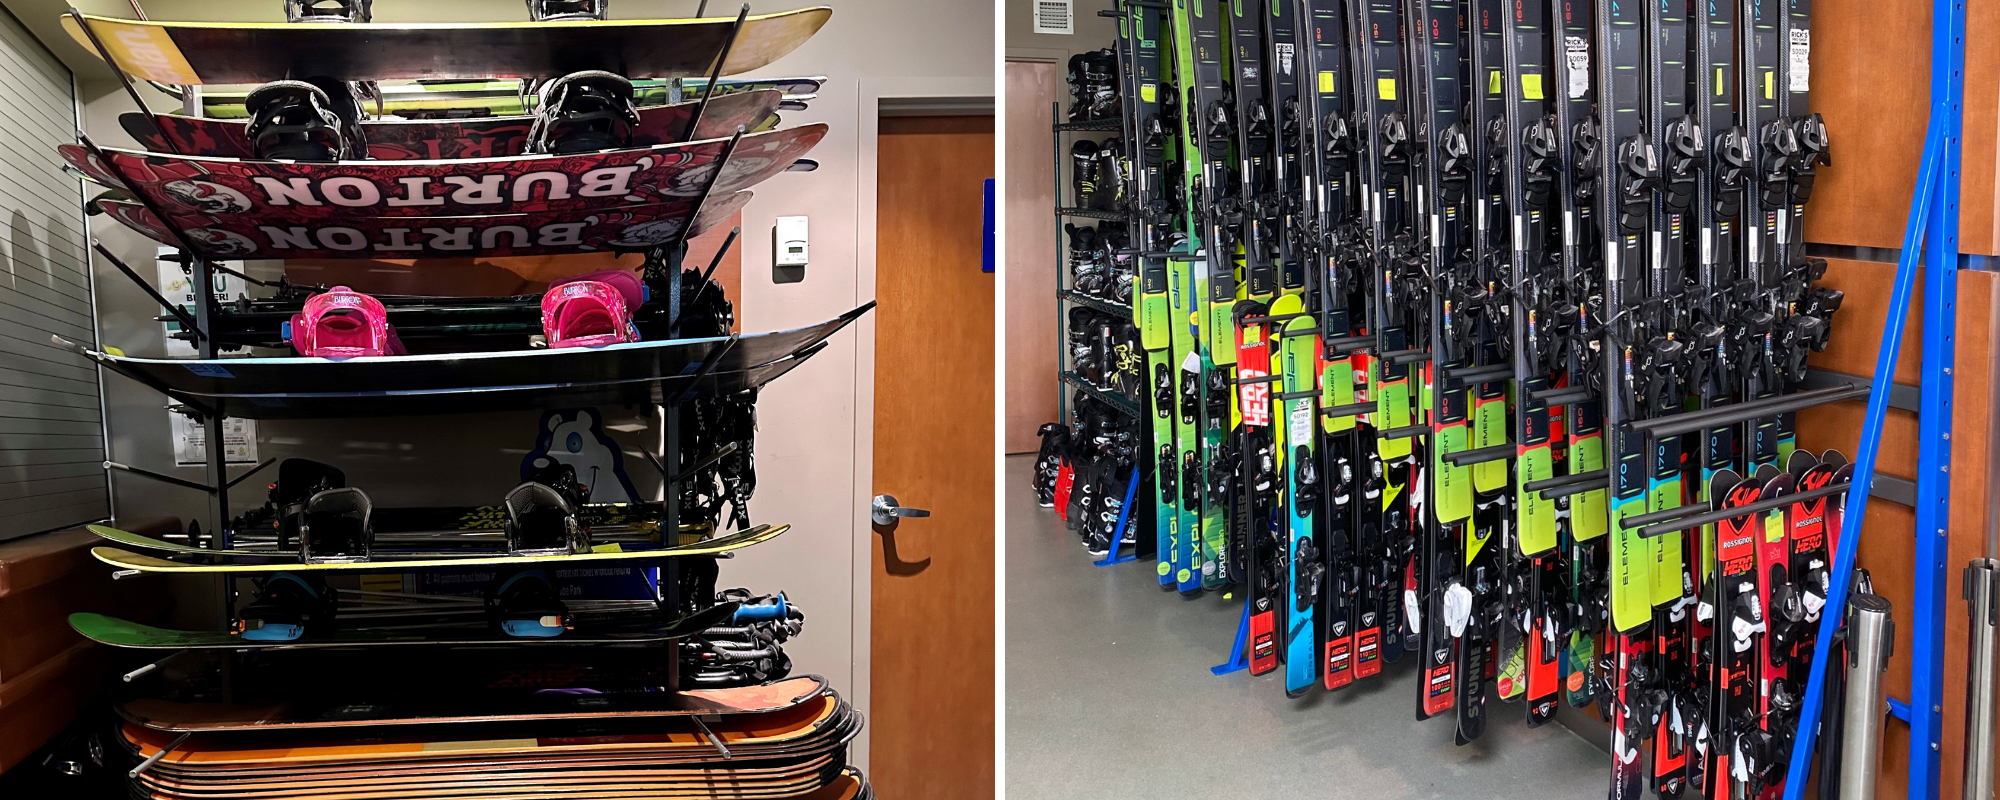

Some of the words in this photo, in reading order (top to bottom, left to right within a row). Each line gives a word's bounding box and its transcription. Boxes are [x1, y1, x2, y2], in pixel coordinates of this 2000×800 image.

[253, 165, 641, 208] BURTON
[258, 222, 590, 252] BURTON
[1795, 516, 1823, 529] ROSSIGNOL
[1621, 510, 1629, 586] ELEMET
[1723, 536, 1753, 549] ROSSIGNOL
[1794, 533, 1823, 554] HERO
[1723, 555, 1753, 577] HERO
[1386, 580, 1397, 645] STUNNE
[1432, 665, 1450, 678] HERO
[1467, 646, 1482, 718] STUNNE
